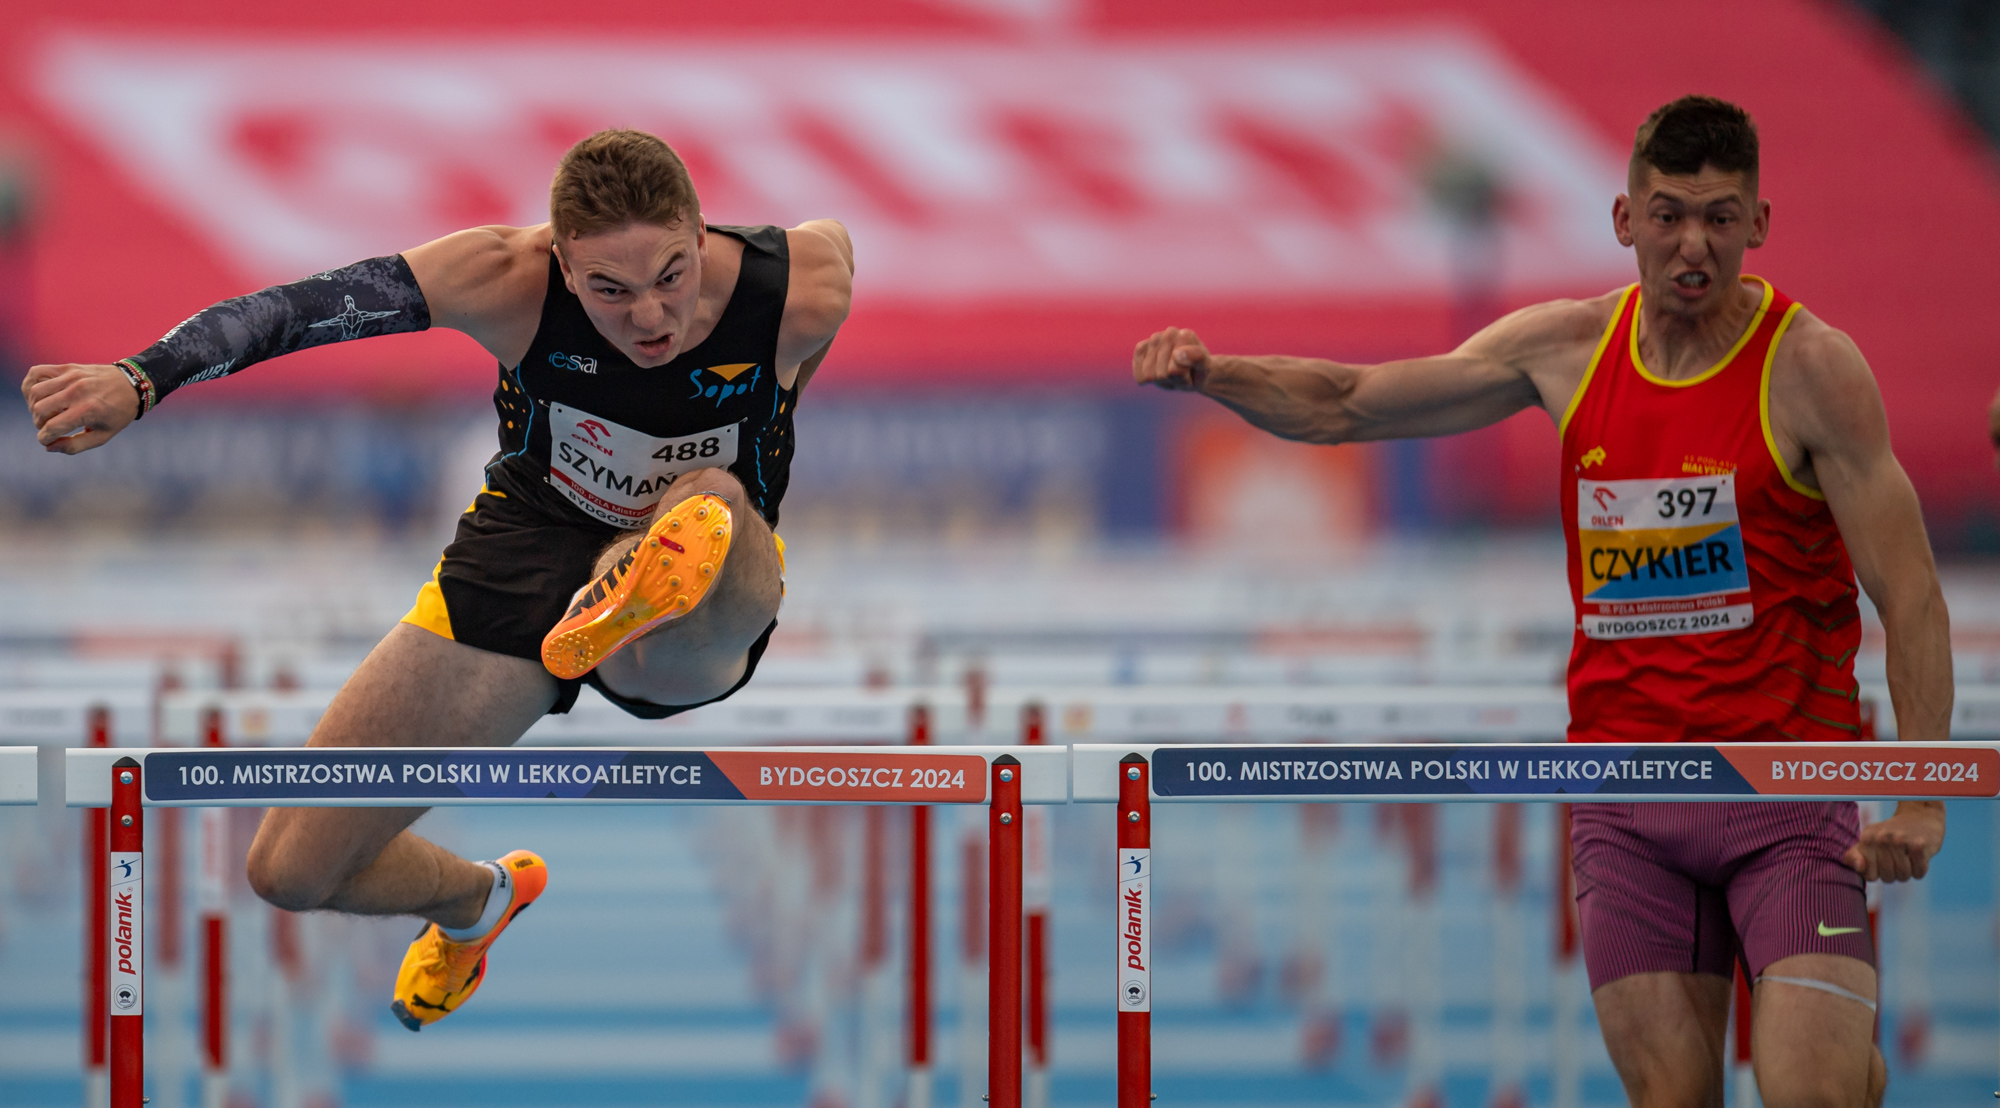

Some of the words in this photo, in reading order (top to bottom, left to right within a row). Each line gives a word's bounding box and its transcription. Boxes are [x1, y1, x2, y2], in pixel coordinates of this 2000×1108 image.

[689, 365, 761, 408] Sopot
[571, 433, 614, 457] ORLEN
[652, 437, 720, 462] 488
[558, 441, 679, 498] SZYMAŃ
[1682, 461, 1733, 475] BIAŁYSTO
[568, 490, 651, 528] BYDGOSZC
[588, 494, 609, 510] PZLA
[611, 504, 657, 518] Mistrzost
[1657, 486, 1717, 519] 397
[1591, 515, 1624, 527] ORLEN
[1590, 541, 1733, 582] CZYKIER
[1613, 602, 1635, 614] PZLA
[1637, 599, 1695, 613] Mistrzostwa
[1697, 595, 1727, 608] Polski
[1598, 618, 1688, 635] BYDGOSZCZ
[1690, 612, 1730, 628] 2024
[178, 765, 225, 786] 100.
[232, 763, 395, 785] MISTRZOSTWA
[402, 763, 481, 785] POLSKI
[489, 764, 511, 785] W
[518, 763, 702, 786] LEKKOATLETYCE
[760, 766, 903, 788] BYDGOSZCZ
[910, 768, 966, 789] 2024
[1186, 761, 1233, 782] 100.
[1240, 760, 1403, 781] MISTRZOSTWA
[1411, 760, 1490, 781] POLSKI
[1498, 760, 1520, 780] W
[1527, 759, 1712, 781] LEKKOATLETYCE
[1771, 760, 1916, 782] BYDGOSZCZ
[1923, 762, 1979, 783] 2024
[115, 891, 137, 976] polanik
[1123, 888, 1146, 972] polanik
